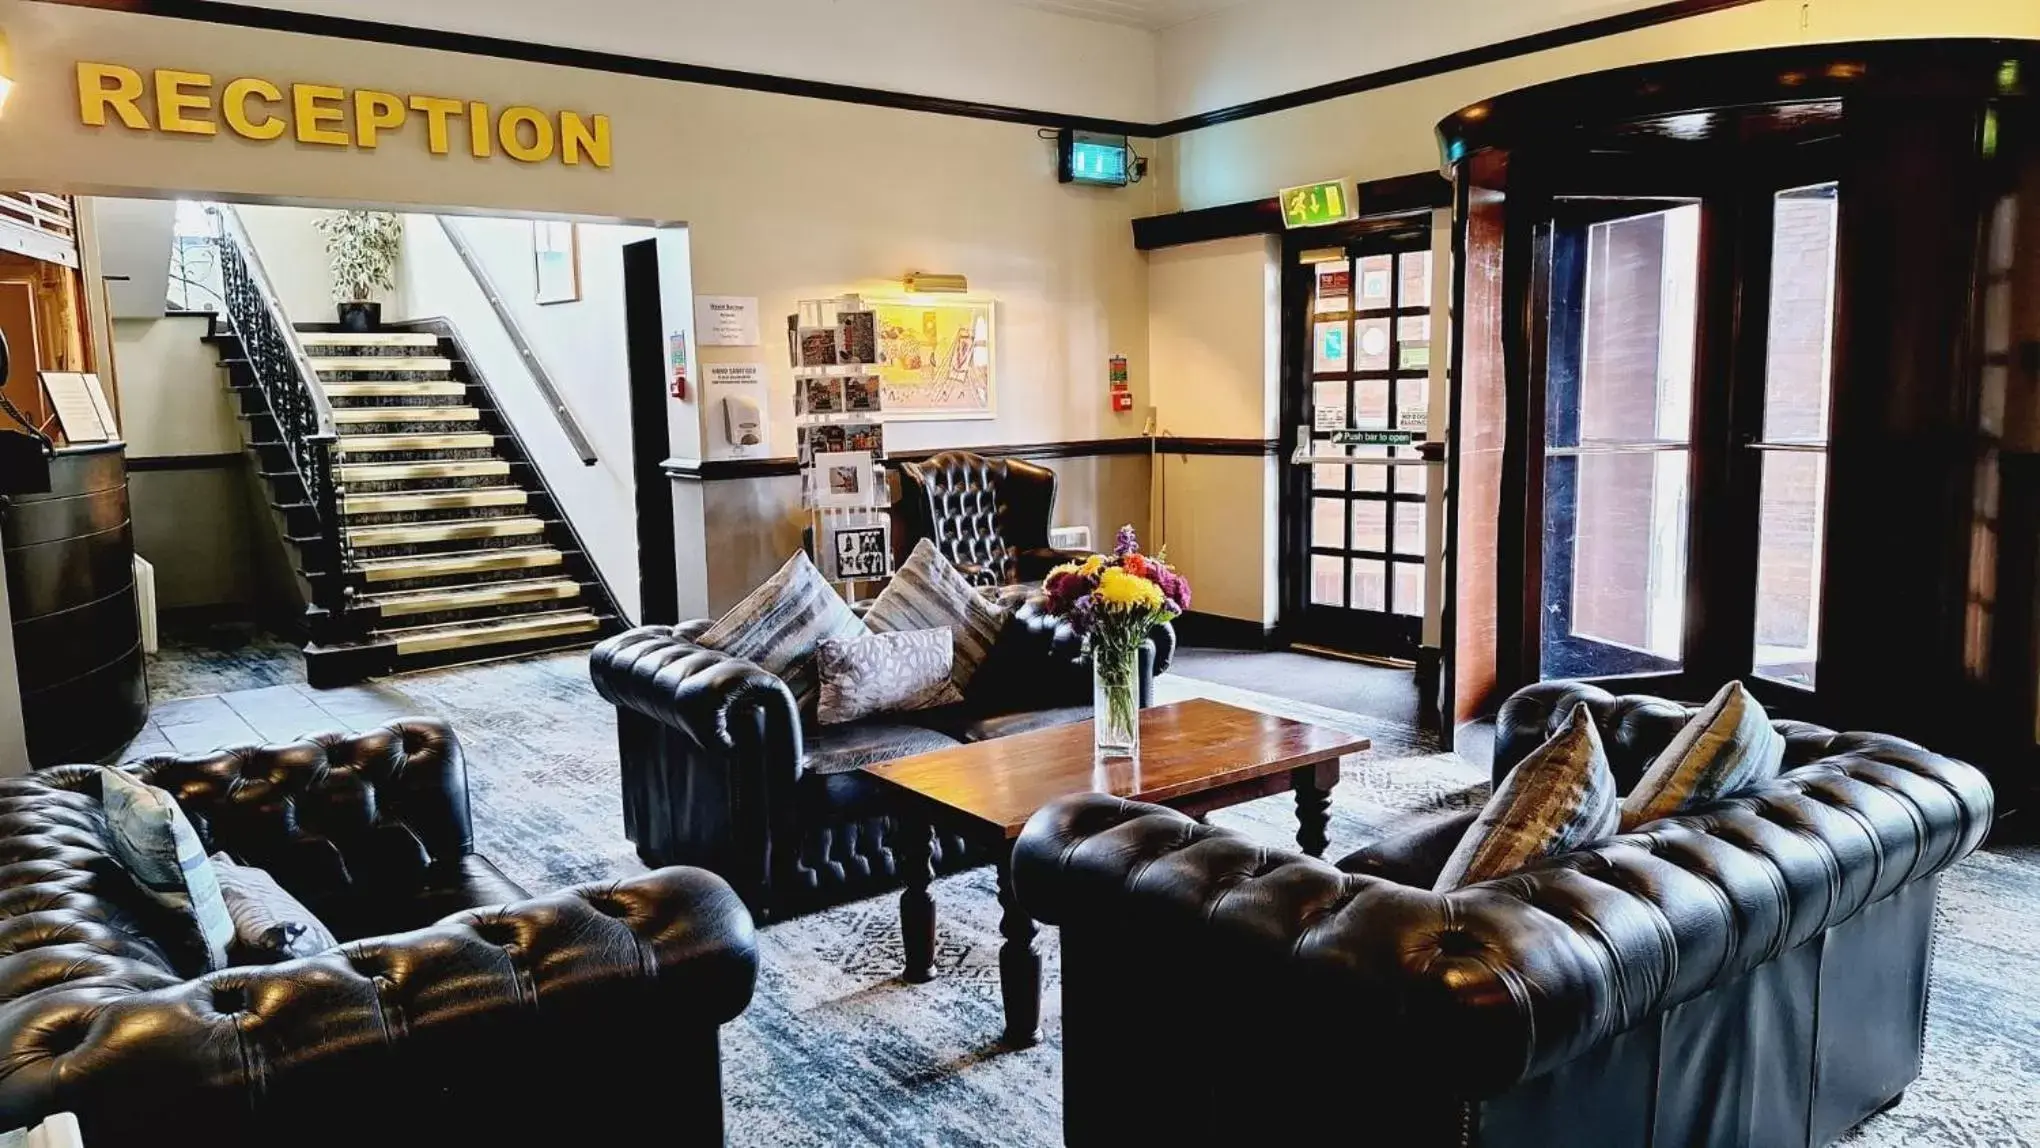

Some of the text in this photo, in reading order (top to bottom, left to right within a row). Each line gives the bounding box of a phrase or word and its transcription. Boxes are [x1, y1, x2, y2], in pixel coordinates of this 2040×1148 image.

[76, 61, 612, 168] RECEPTION
[1344, 432, 1410, 442] Push bar to open
